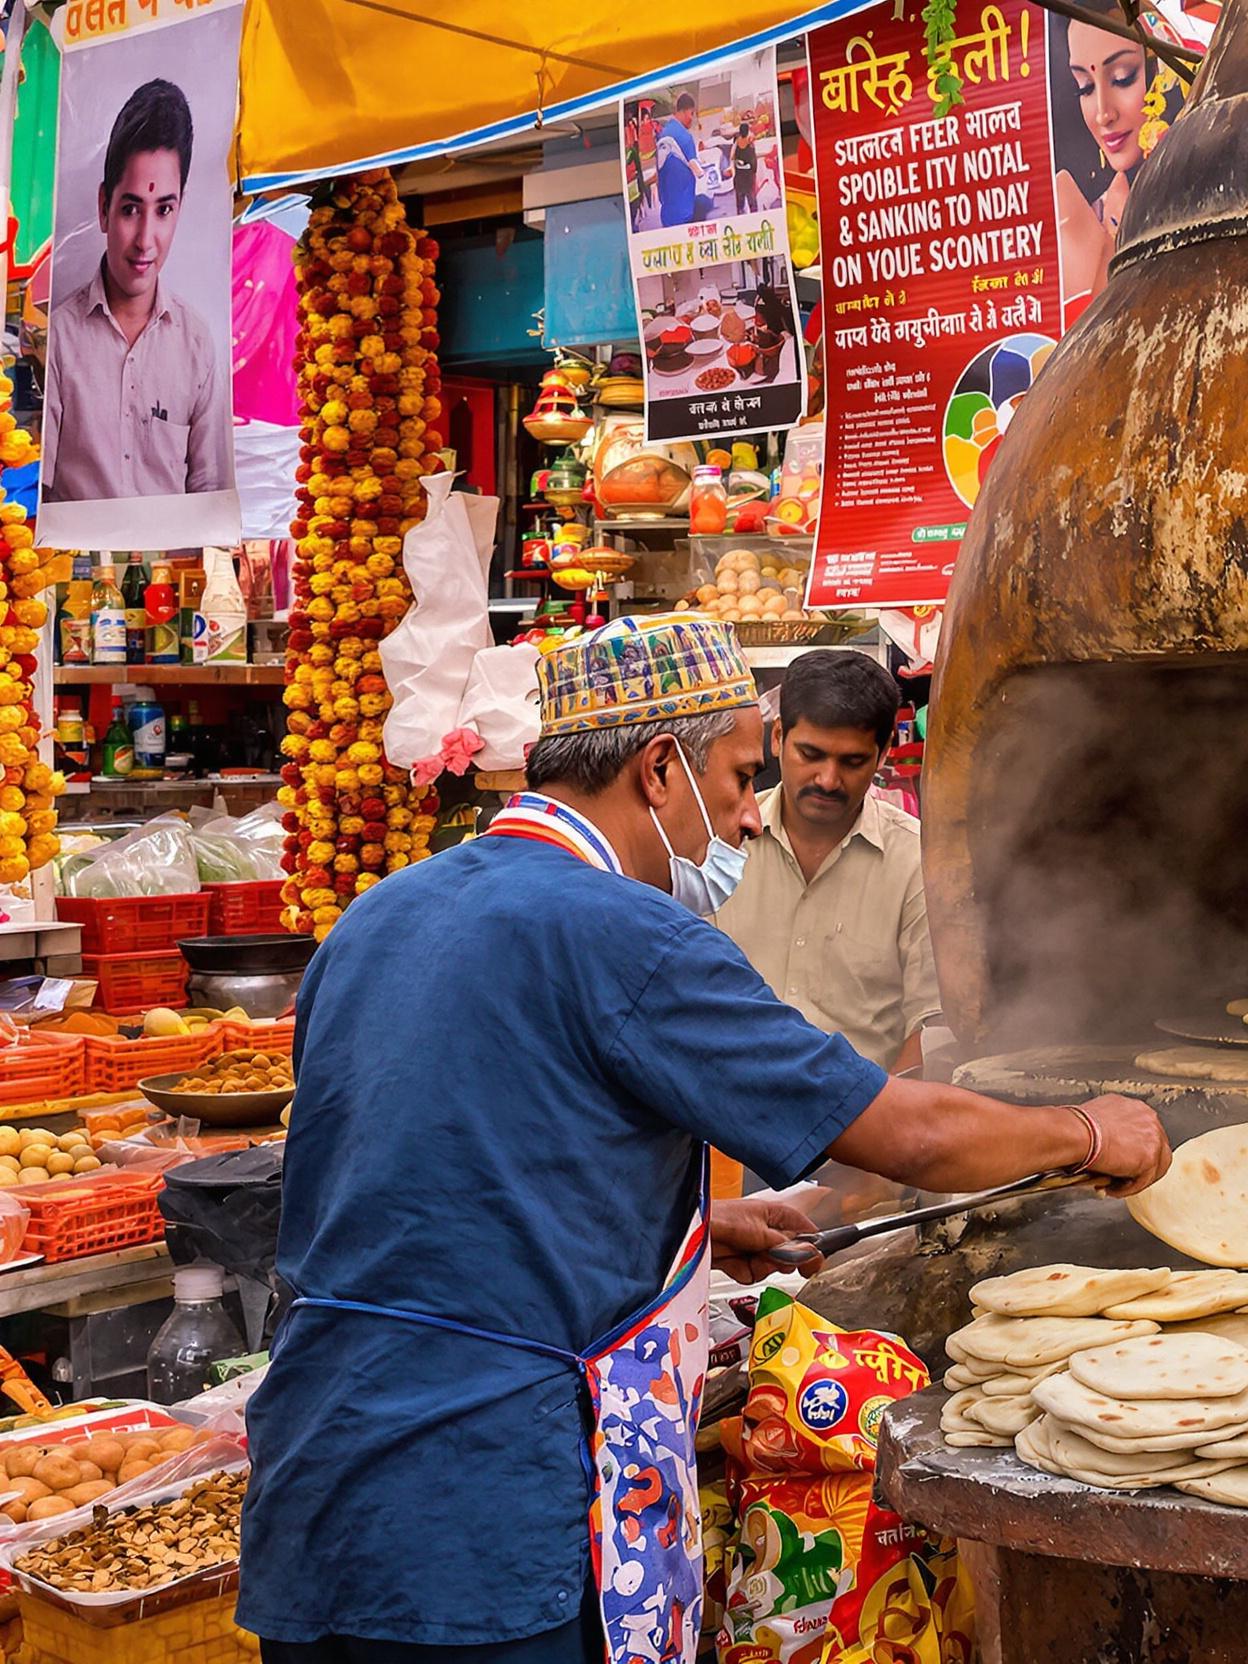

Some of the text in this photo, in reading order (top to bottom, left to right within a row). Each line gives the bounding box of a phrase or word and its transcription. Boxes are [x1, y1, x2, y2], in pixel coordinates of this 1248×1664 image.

[909, 116, 960, 153] FEER
[838, 140, 1030, 206] SPOIBLE ITY NOTAL
[839, 181, 1029, 247] & SANKING TO NDAY
[832, 221, 1043, 288] ON YOUE SCONTERY
